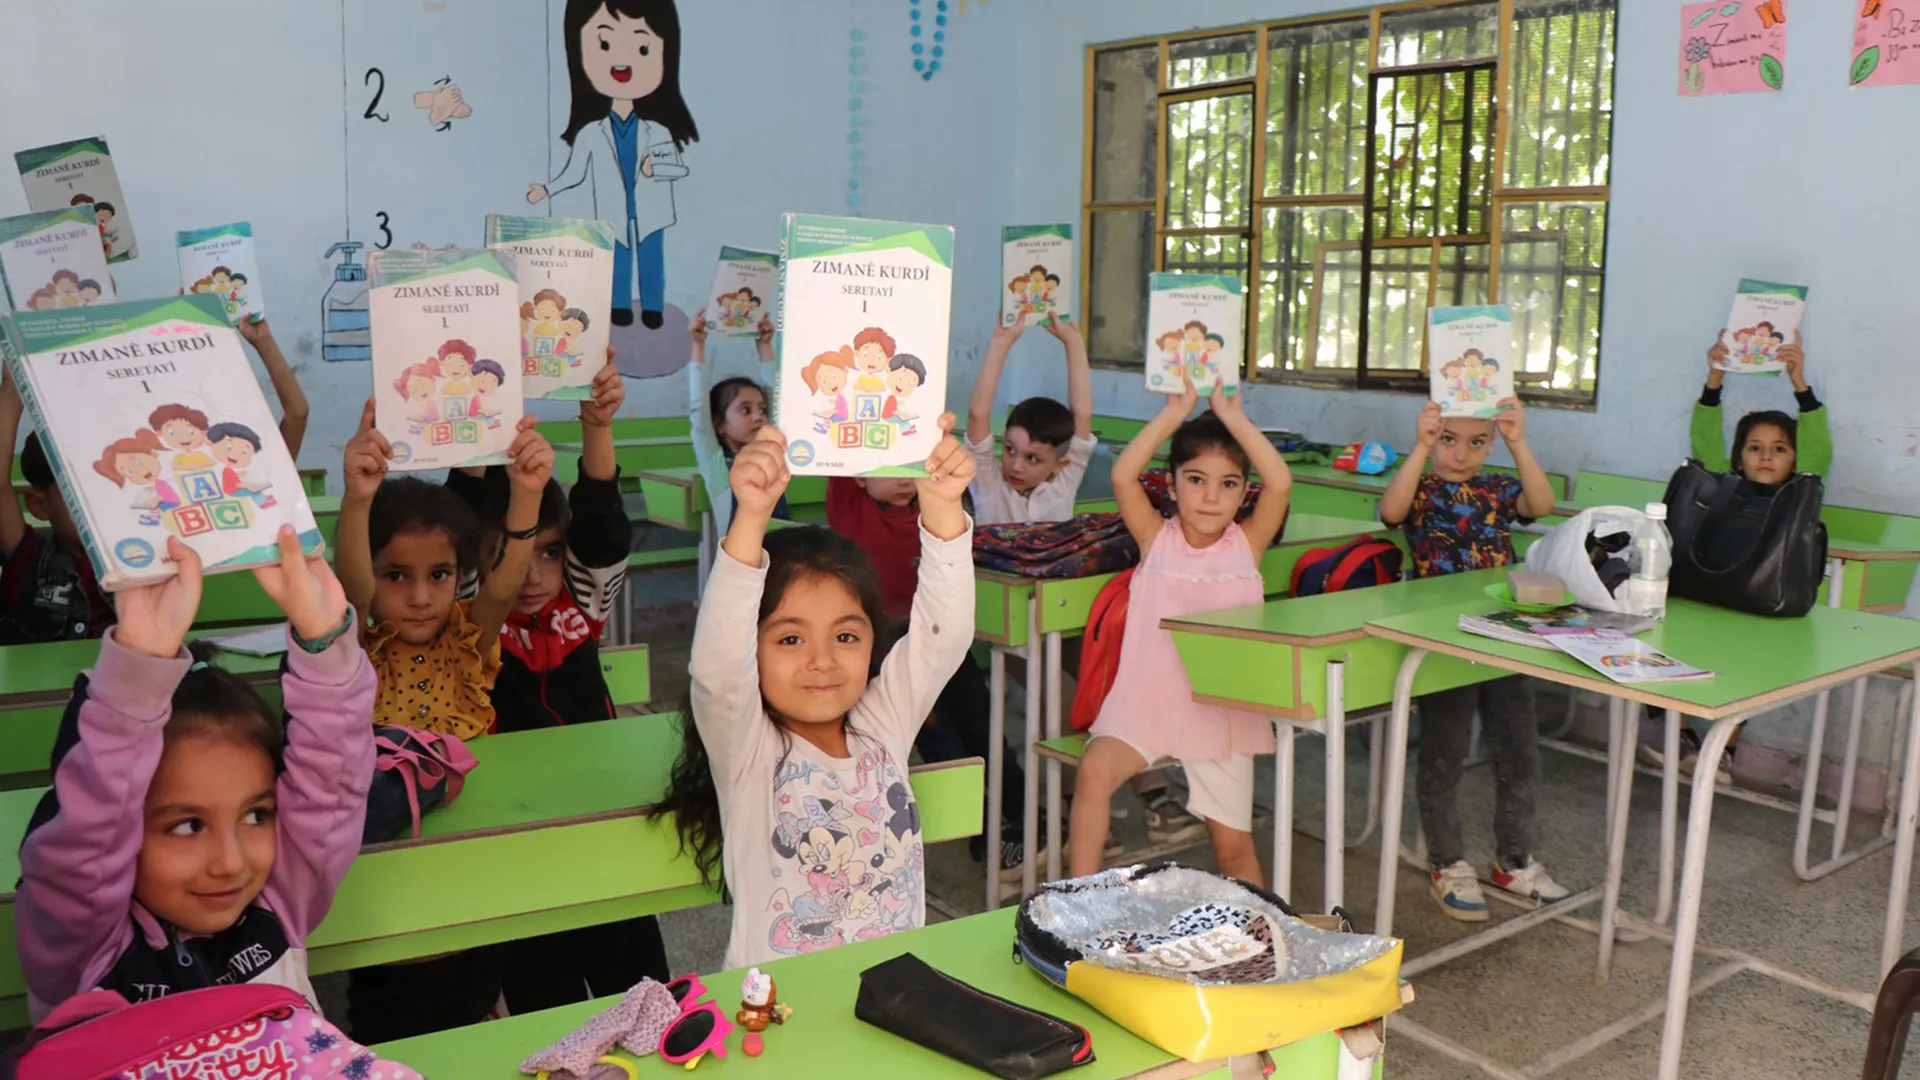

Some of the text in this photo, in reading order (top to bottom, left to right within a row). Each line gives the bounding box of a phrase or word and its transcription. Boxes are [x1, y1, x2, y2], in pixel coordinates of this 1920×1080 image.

[363, 67, 390, 122] 2
[374, 211, 393, 249] 3
[812, 260, 930, 281] ZIMANÊ KURDÎ
[394, 282, 500, 298] ZIMANÊ KURDÎ
[57, 332, 216, 366] ZIMANÊ KURDÎ
[523, 358, 537, 373] B
[451, 402, 463, 417] A
[859, 399, 876, 418] A
[435, 424, 474, 442] B C
[841, 426, 886, 445] B C
[192, 477, 218, 499] A
[179, 505, 243, 533] B C
